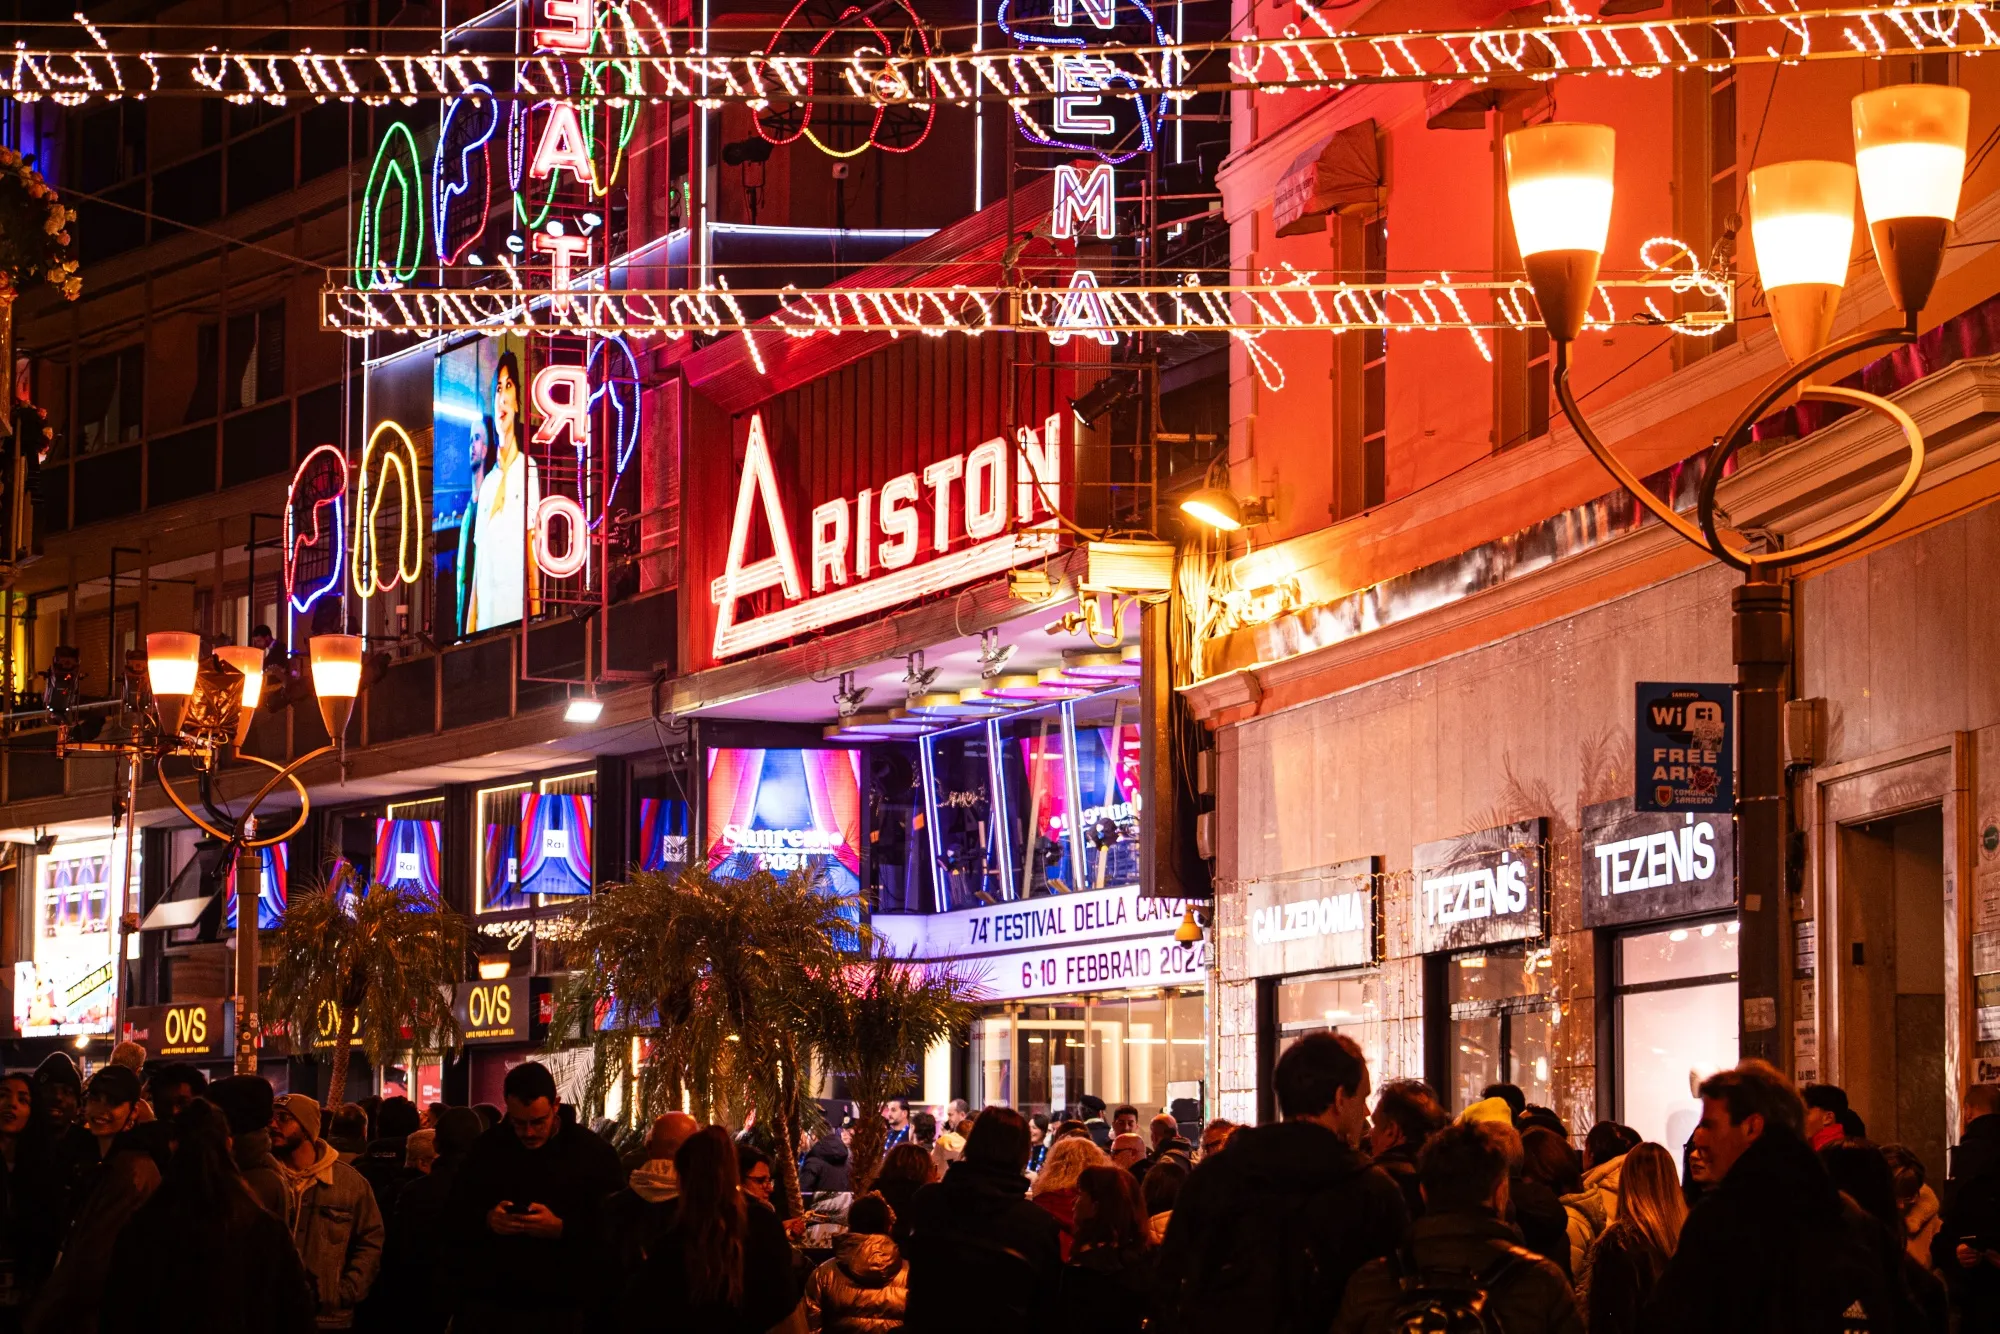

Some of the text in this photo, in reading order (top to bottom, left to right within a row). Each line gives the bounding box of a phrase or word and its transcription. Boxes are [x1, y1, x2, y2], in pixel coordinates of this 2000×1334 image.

[710, 412, 1061, 658] ARISTON
[1652, 766, 1715, 781] AR
[1653, 748, 1717, 764] FREE
[547, 838, 565, 849] Rai
[400, 861, 416, 871] Rai
[995, 907, 1067, 943] FESTIVAL
[1074, 896, 1128, 931] DELLA
[1252, 891, 1364, 946] CALZEDONIA
[1067, 948, 1151, 985] FEBBRAIO
[469, 984, 511, 1027] OVS
[165, 1007, 207, 1045] OVS
